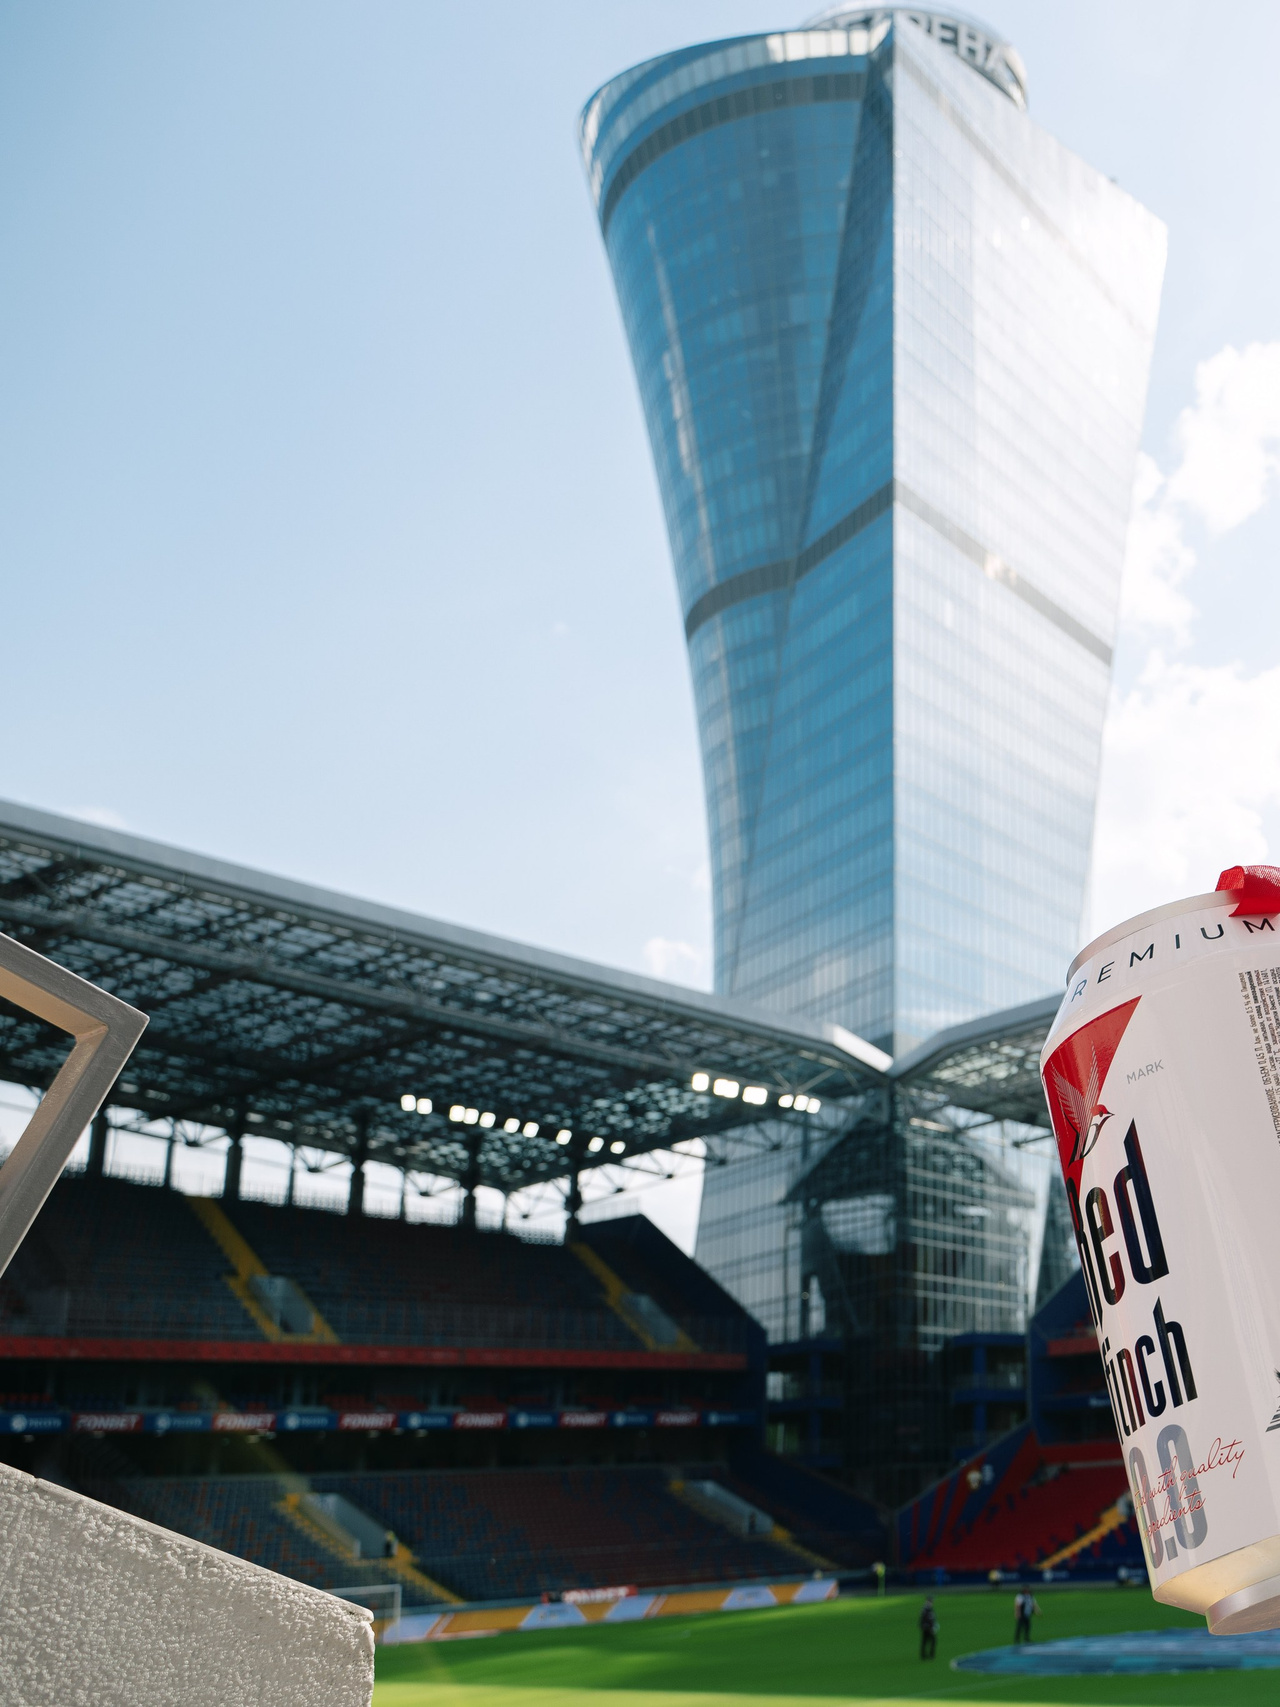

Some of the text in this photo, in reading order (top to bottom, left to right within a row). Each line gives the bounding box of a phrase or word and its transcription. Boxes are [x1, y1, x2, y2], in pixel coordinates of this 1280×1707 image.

[1070, 917, 1276, 1002] REMIUM
[1126, 1059, 1164, 1084] MARK
[1143, 1489, 1206, 1541] gredients
